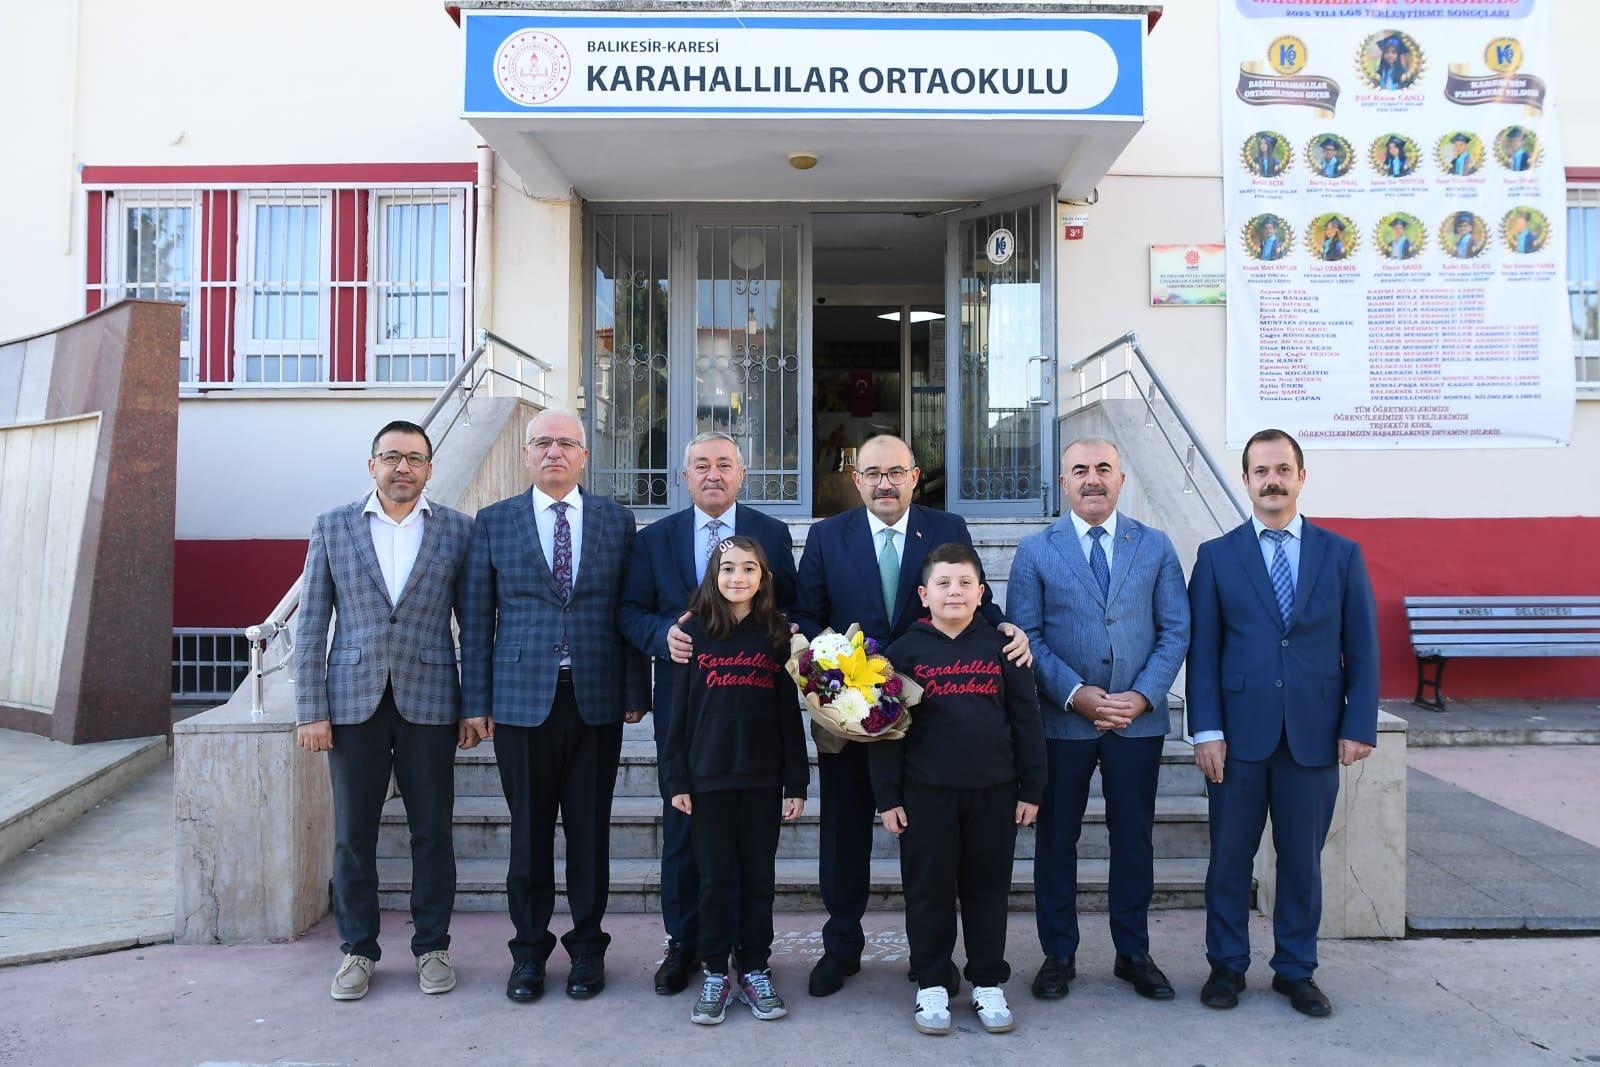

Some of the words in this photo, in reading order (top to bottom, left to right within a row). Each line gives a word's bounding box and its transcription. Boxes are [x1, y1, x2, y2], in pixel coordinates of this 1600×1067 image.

[587, 39, 718, 54] BALIKESİR-KARESİ
[586, 65, 849, 93] KARAHALLILAR
[858, 67, 1069, 95] ORTAOKULU
[1458, 608, 1493, 616] KARESİ
[1514, 607, 1572, 616] BELEDİYESİ
